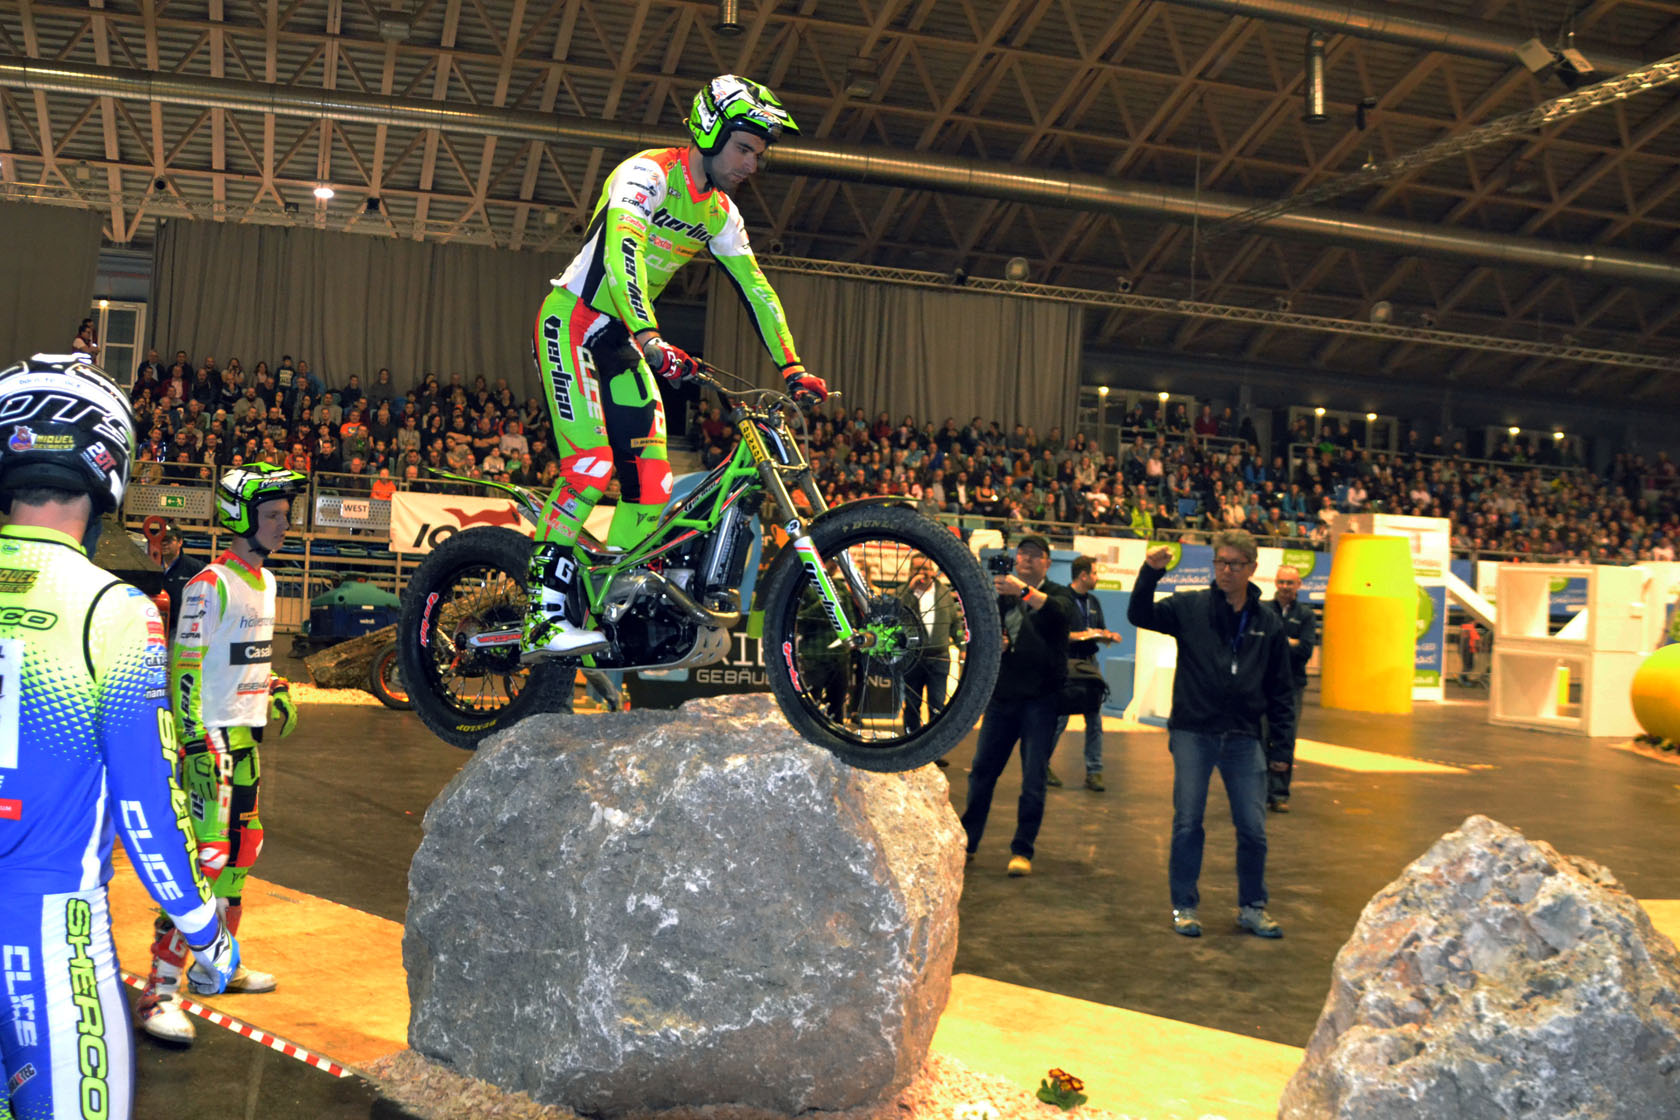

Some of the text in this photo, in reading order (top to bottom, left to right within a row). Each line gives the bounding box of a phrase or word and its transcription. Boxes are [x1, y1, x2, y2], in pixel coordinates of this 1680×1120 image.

[37, 435, 74, 444] MIQUEL
[344, 504, 367, 512] WEST
[119, 799, 184, 901] CLICE
[65, 897, 110, 1120] SHERCO
